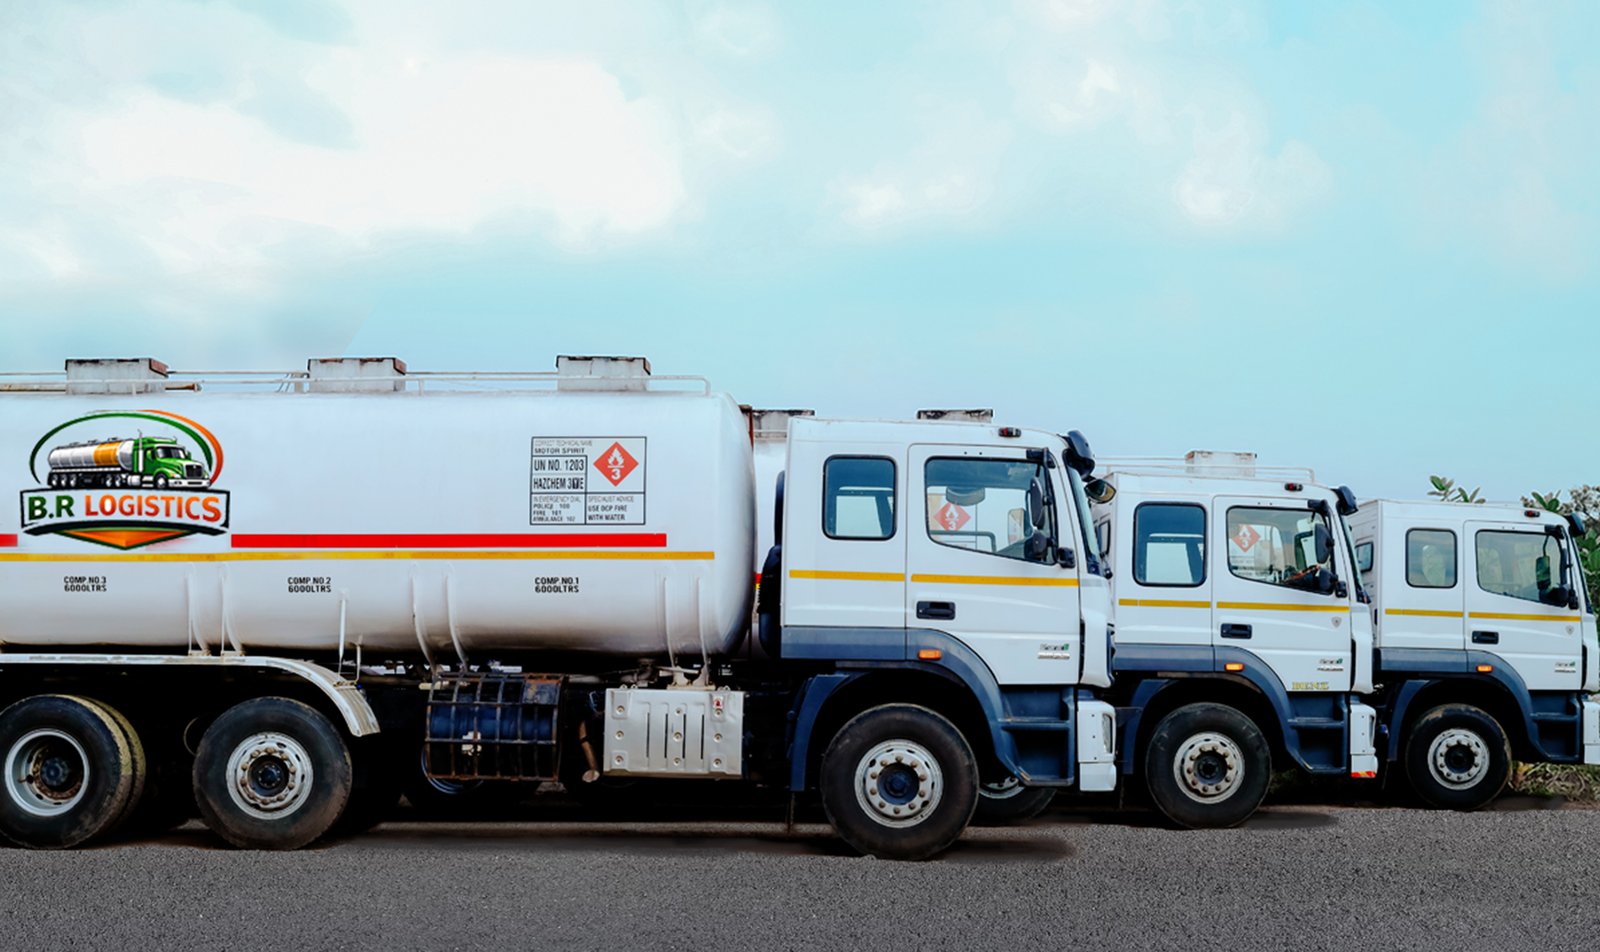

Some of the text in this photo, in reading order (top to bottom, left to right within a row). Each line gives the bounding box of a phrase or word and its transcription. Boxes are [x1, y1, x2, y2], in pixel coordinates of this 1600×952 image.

[534, 459, 546, 471] UN
[565, 459, 584, 471] 1203
[611, 468, 621, 480] 3
[534, 477, 566, 489] HAZCHEM
[28, 494, 222, 522] B.R LOGISTICS
[64, 584, 107, 592] 6000LTRS
[288, 585, 331, 593] 6000LTRS
[534, 585, 579, 593] 6000LTRS
